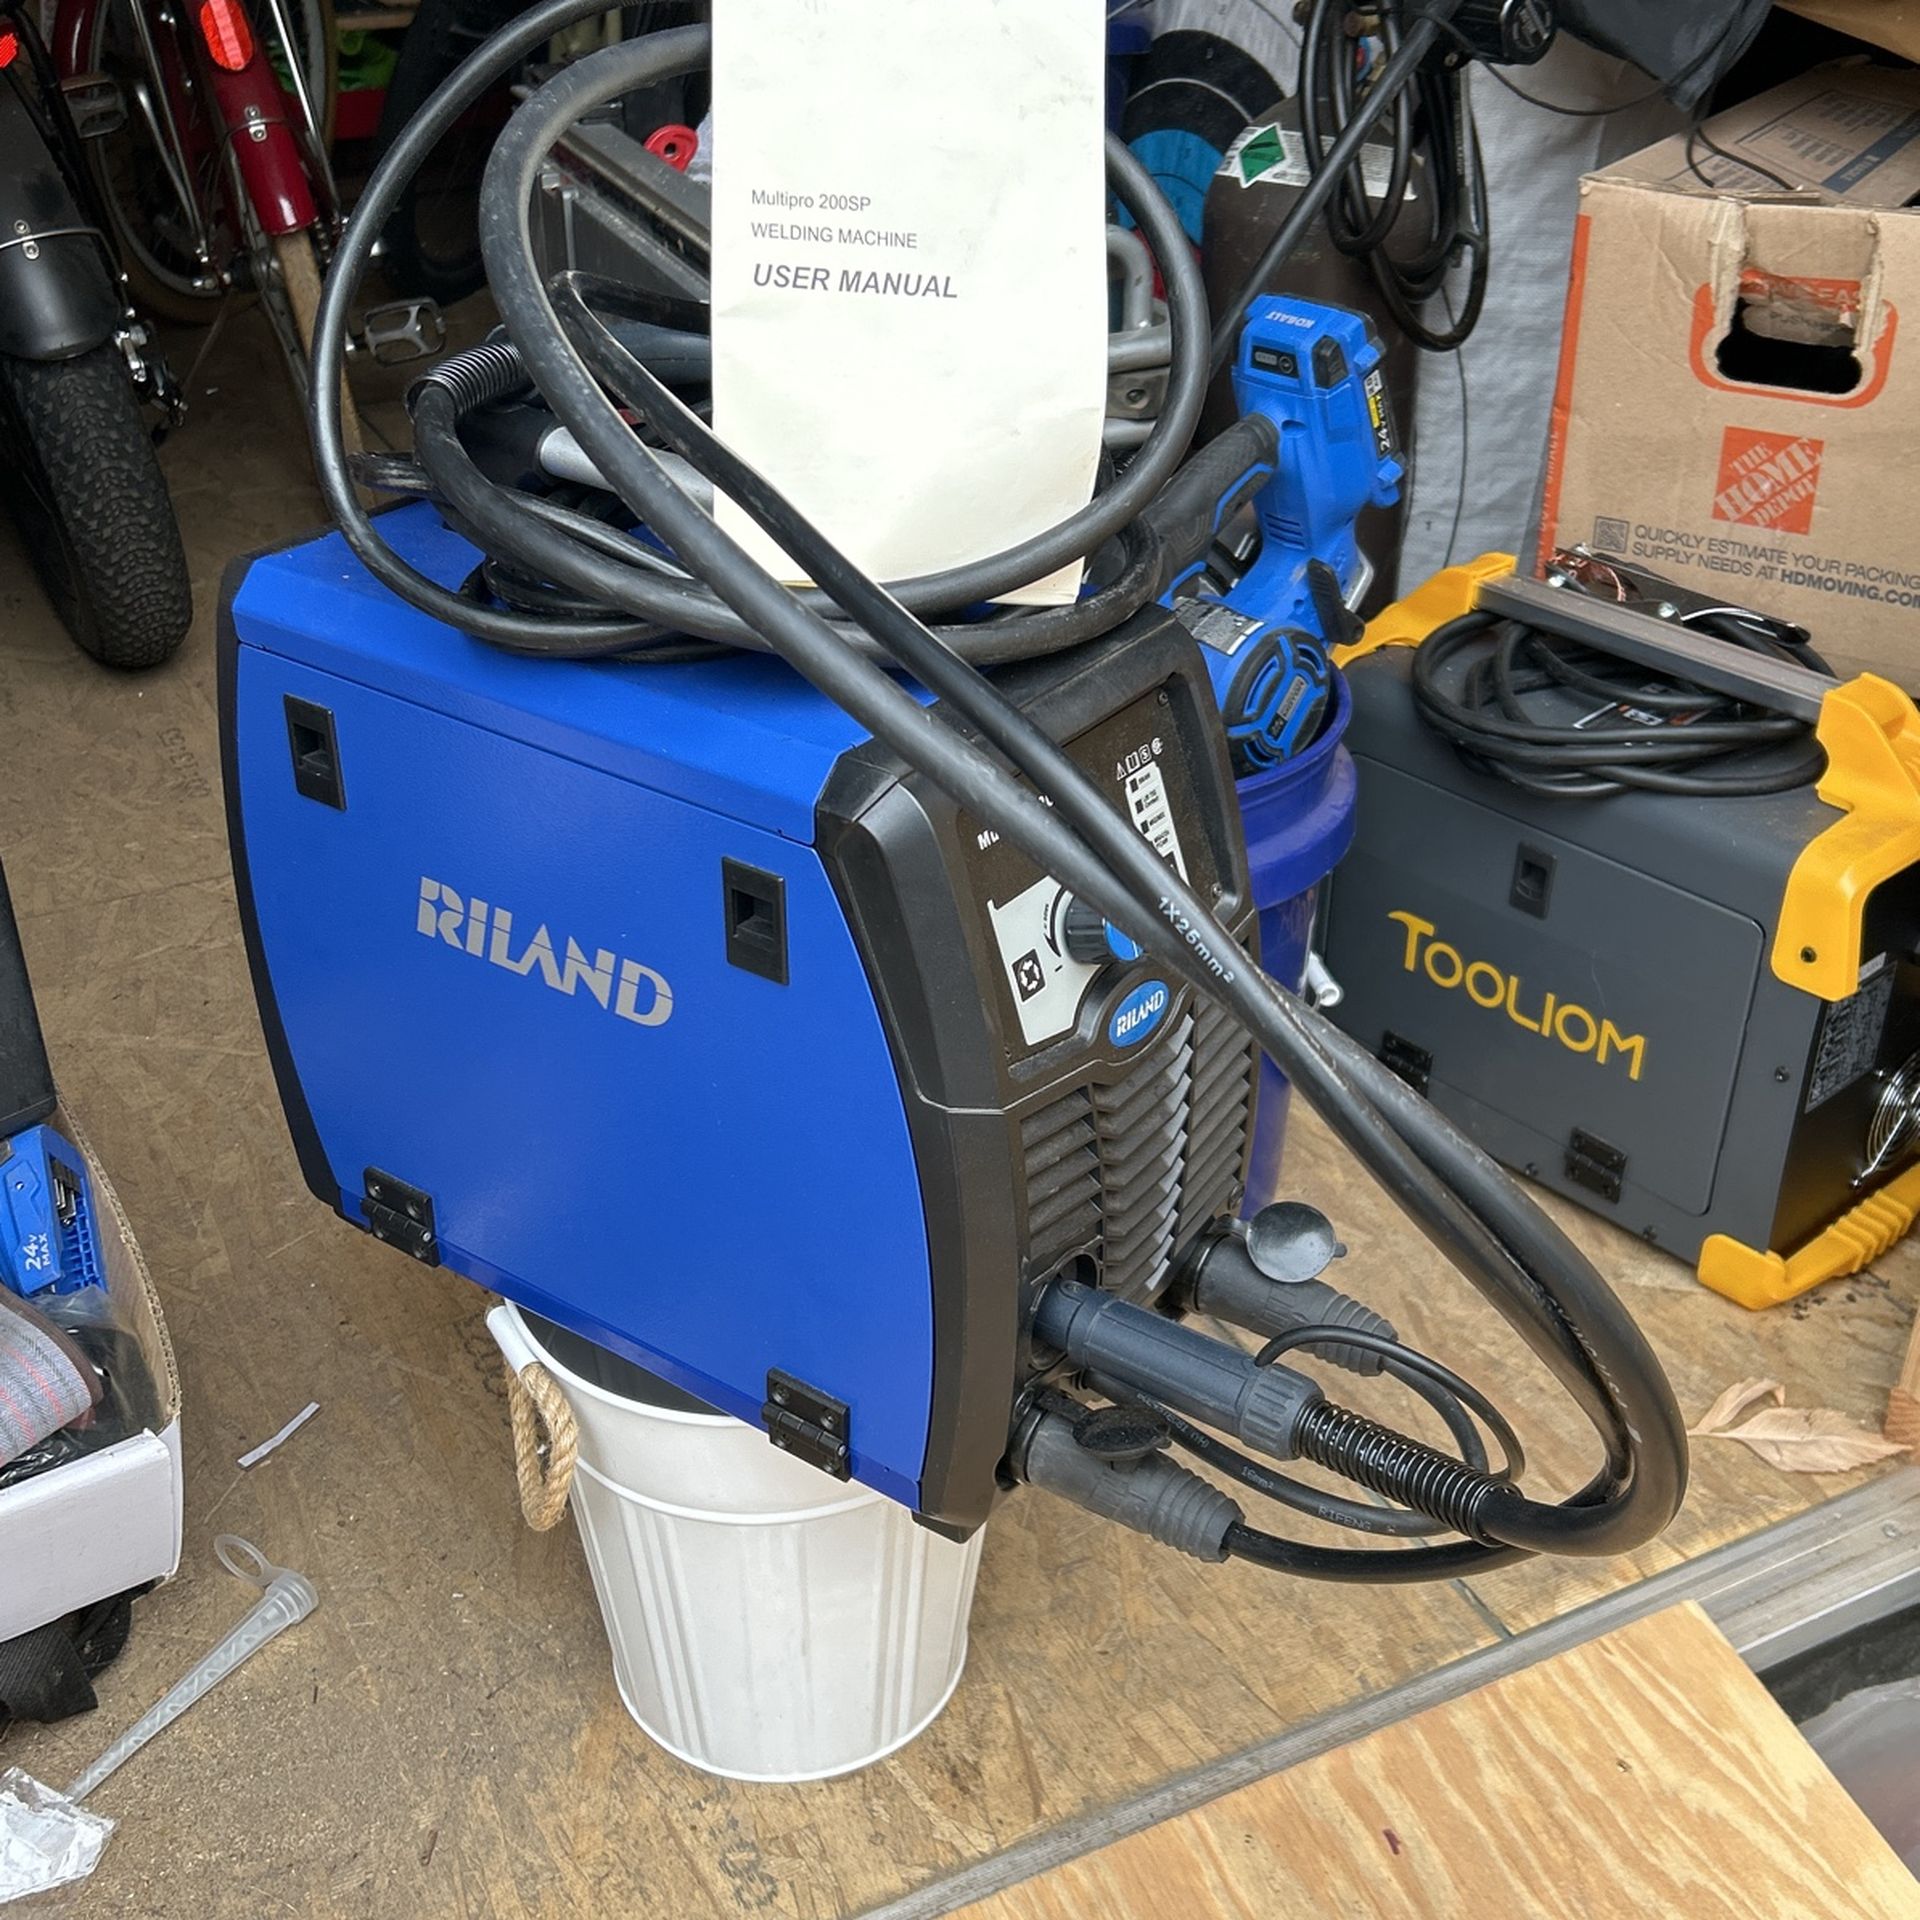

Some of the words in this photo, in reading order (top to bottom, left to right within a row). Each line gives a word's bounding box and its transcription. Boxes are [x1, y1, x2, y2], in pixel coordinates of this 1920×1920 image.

[751, 189, 814, 210] Multipro
[819, 193, 871, 211] 200SP
[751, 222, 833, 243] WELDING
[838, 228, 918, 249] MACHINE
[753, 263, 830, 291] USER
[838, 269, 958, 298] MANUAL
[1265, 311, 1316, 329] KOBALT
[1728, 441, 1773, 476] THE
[1714, 436, 1822, 522] HOME
[1751, 473, 1816, 526] DEPOT
[1632, 542, 1695, 565] SUPPLY
[1697, 554, 1754, 577] NEEDS
[1756, 565, 1779, 581] AT
[1634, 524, 1705, 549] QUICKLY
[1708, 538, 1788, 566] ESTIMATE
[1792, 552, 1842, 575] YOUR
[1845, 563, 1920, 590] PACKING
[416, 876, 674, 1027] RILAND
[1116, 990, 1164, 1038] RILAND
[38, 1233, 51, 1266] MAX
